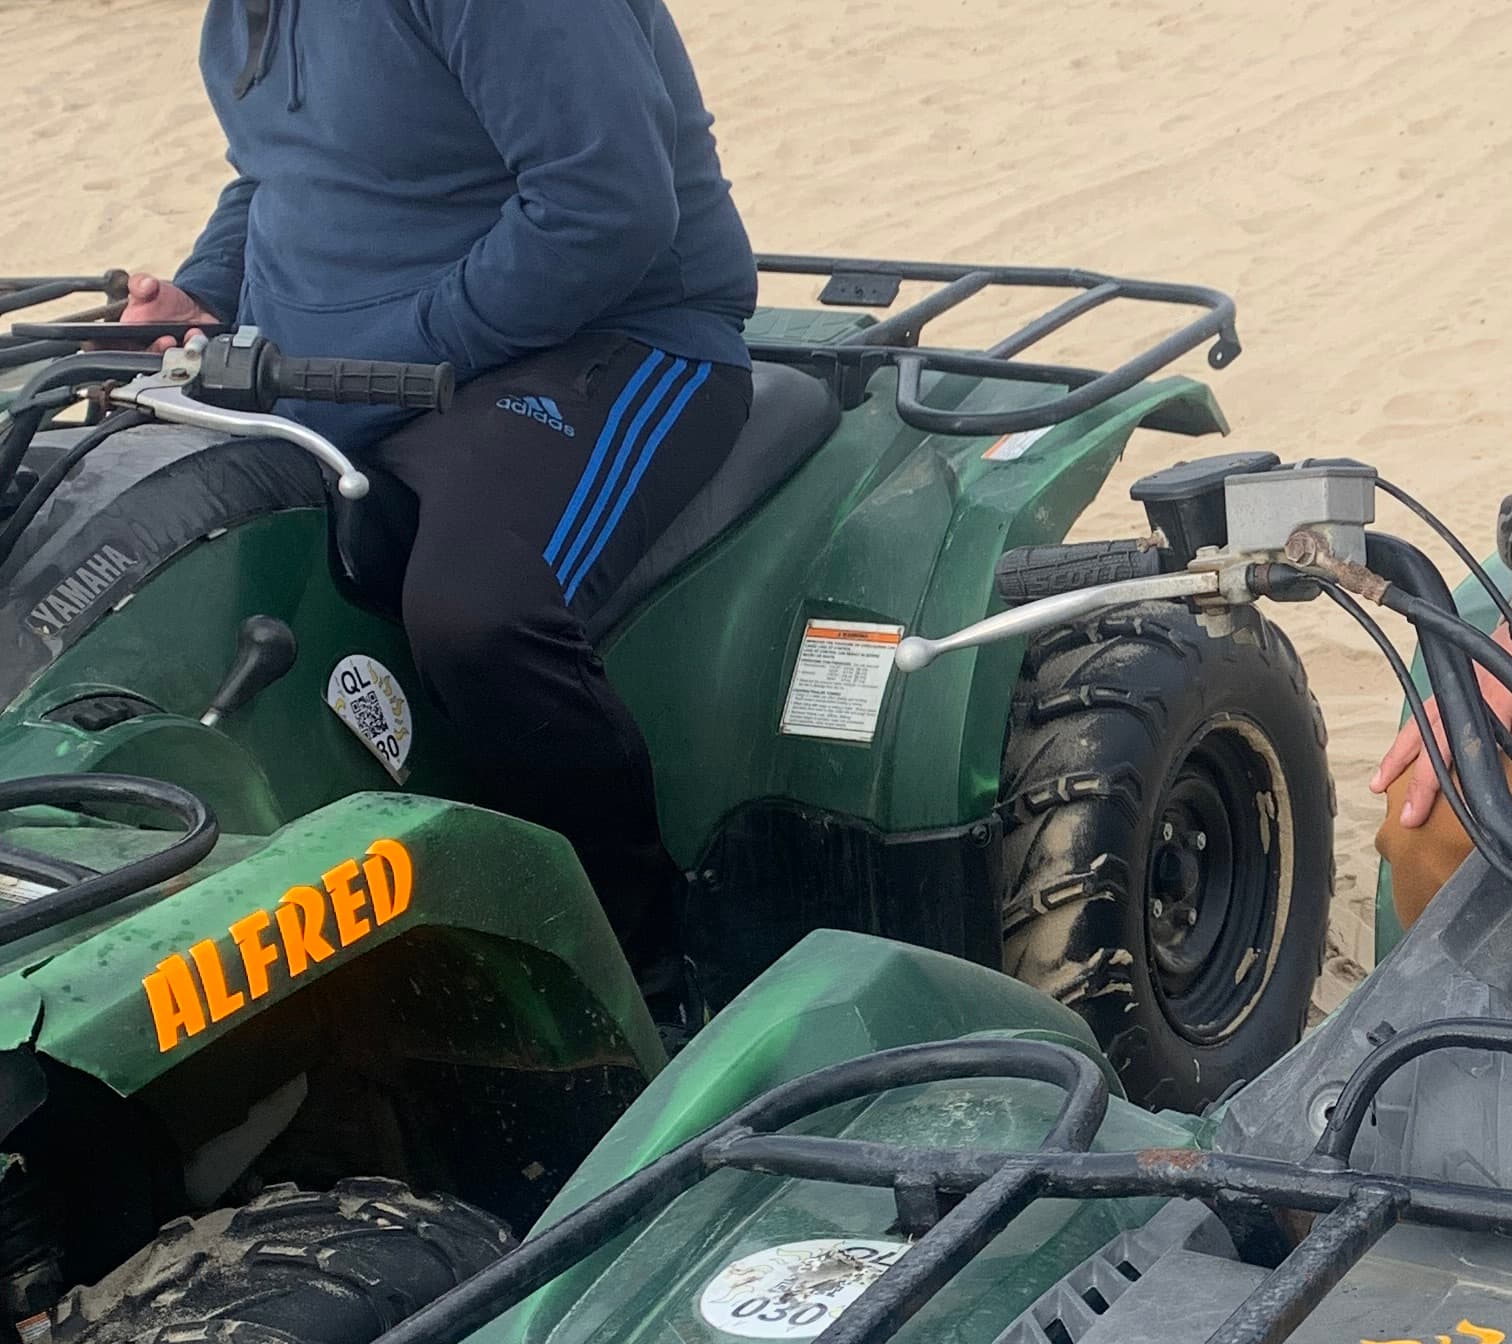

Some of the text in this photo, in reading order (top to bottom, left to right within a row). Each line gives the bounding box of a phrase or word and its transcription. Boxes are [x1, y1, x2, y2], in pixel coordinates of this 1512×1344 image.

[495, 394, 576, 438] adidas
[30, 544, 132, 630] YAMAHA
[340, 666, 372, 695] QL
[376, 734, 400, 761] 30
[142, 838, 413, 1053] ALFRED
[731, 1296, 828, 1326] 030
